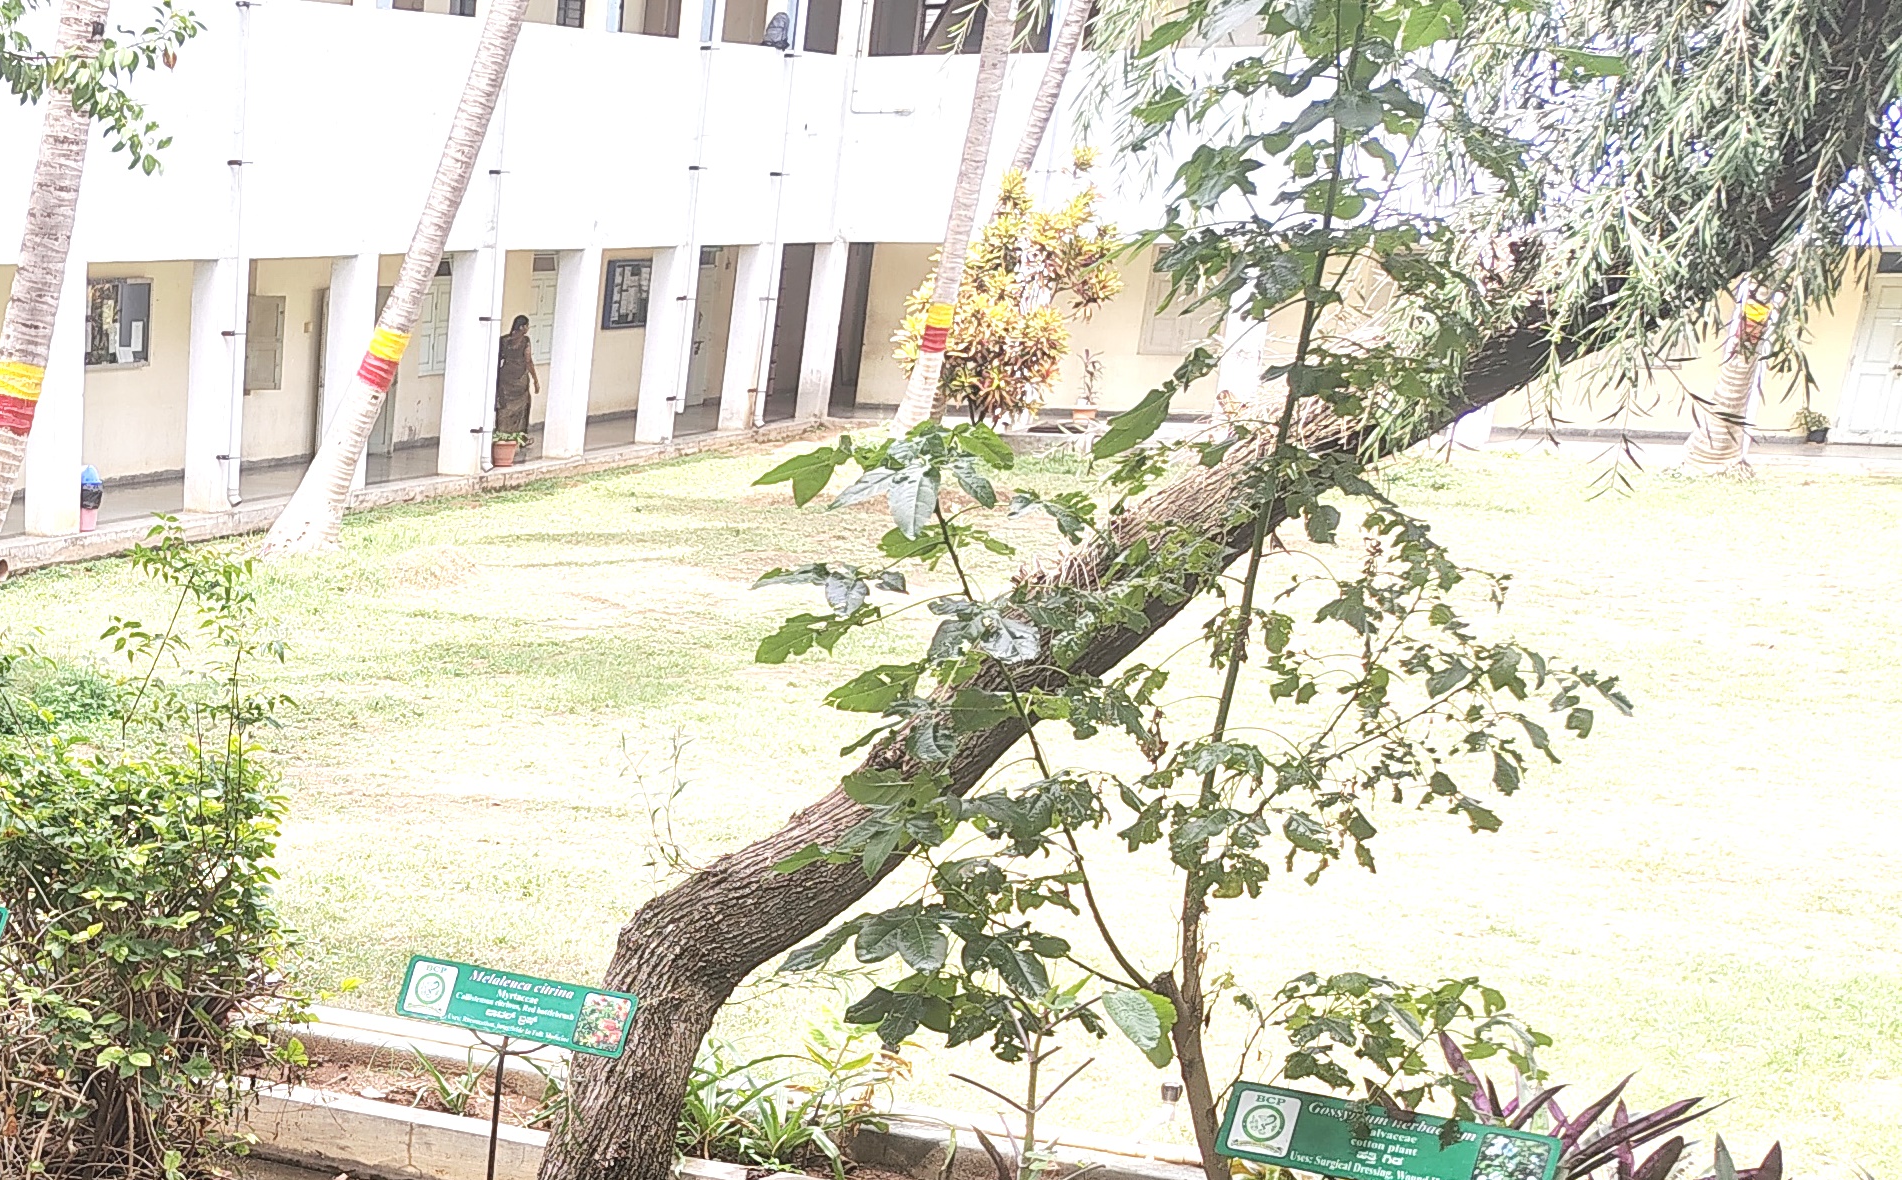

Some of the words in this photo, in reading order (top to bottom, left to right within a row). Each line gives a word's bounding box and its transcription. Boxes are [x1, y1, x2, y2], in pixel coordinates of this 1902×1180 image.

[1255, 1094, 1286, 1106] BCP
[1369, 1128, 1418, 1144] alvaceae
[1350, 1138, 1386, 1151] cotton
[1386, 1144, 1418, 1156] plant
[1289, 1150, 1314, 1164] Uses:
[1313, 1155, 1352, 1171] Surgical
